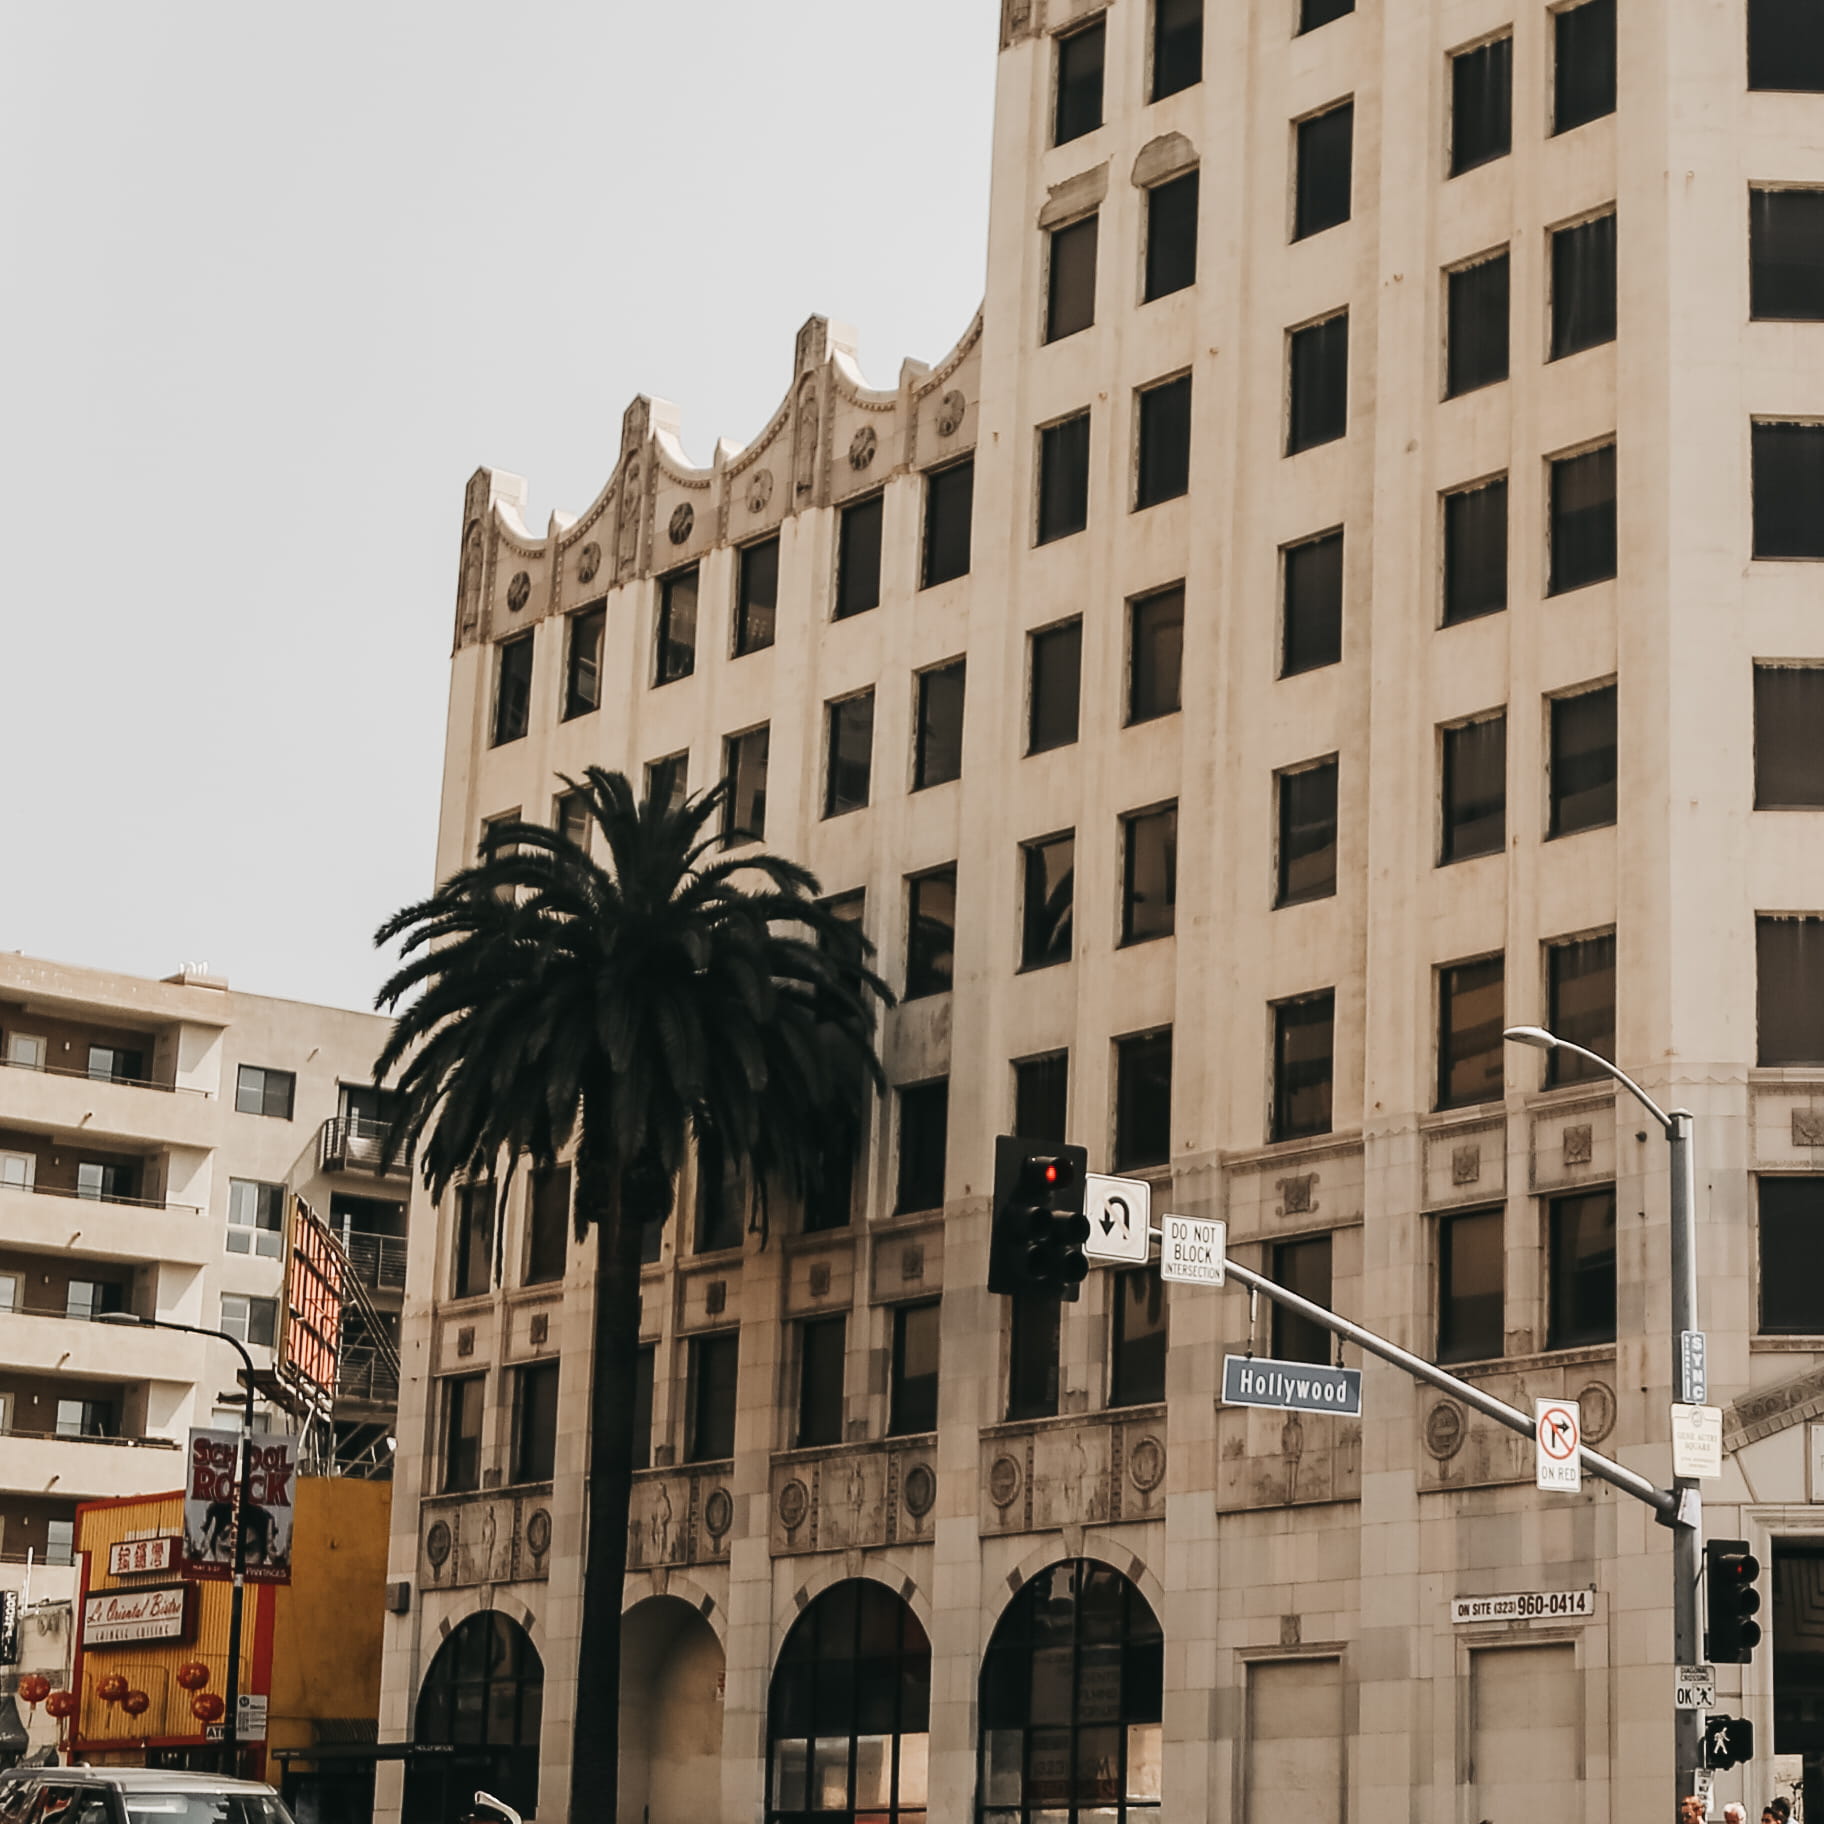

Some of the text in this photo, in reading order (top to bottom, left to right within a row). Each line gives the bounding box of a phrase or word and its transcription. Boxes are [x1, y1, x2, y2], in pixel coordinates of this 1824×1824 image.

[1172, 1223, 1216, 1243] DO NOT
[1174, 1244, 1212, 1263] BLOCK
[1165, 1263, 1220, 1279] INTERSECTION
[1240, 1369, 1347, 1404] Hollywood
[1542, 1466, 1576, 1481] ON RED
[192, 1465, 292, 1506] ROCK
[106, 1598, 150, 1622] Oriental
[150, 1593, 181, 1617] Bistro
[1458, 1593, 1585, 1616] ON SITE (323) 960-0414
[1677, 1688, 1692, 1704] OK
